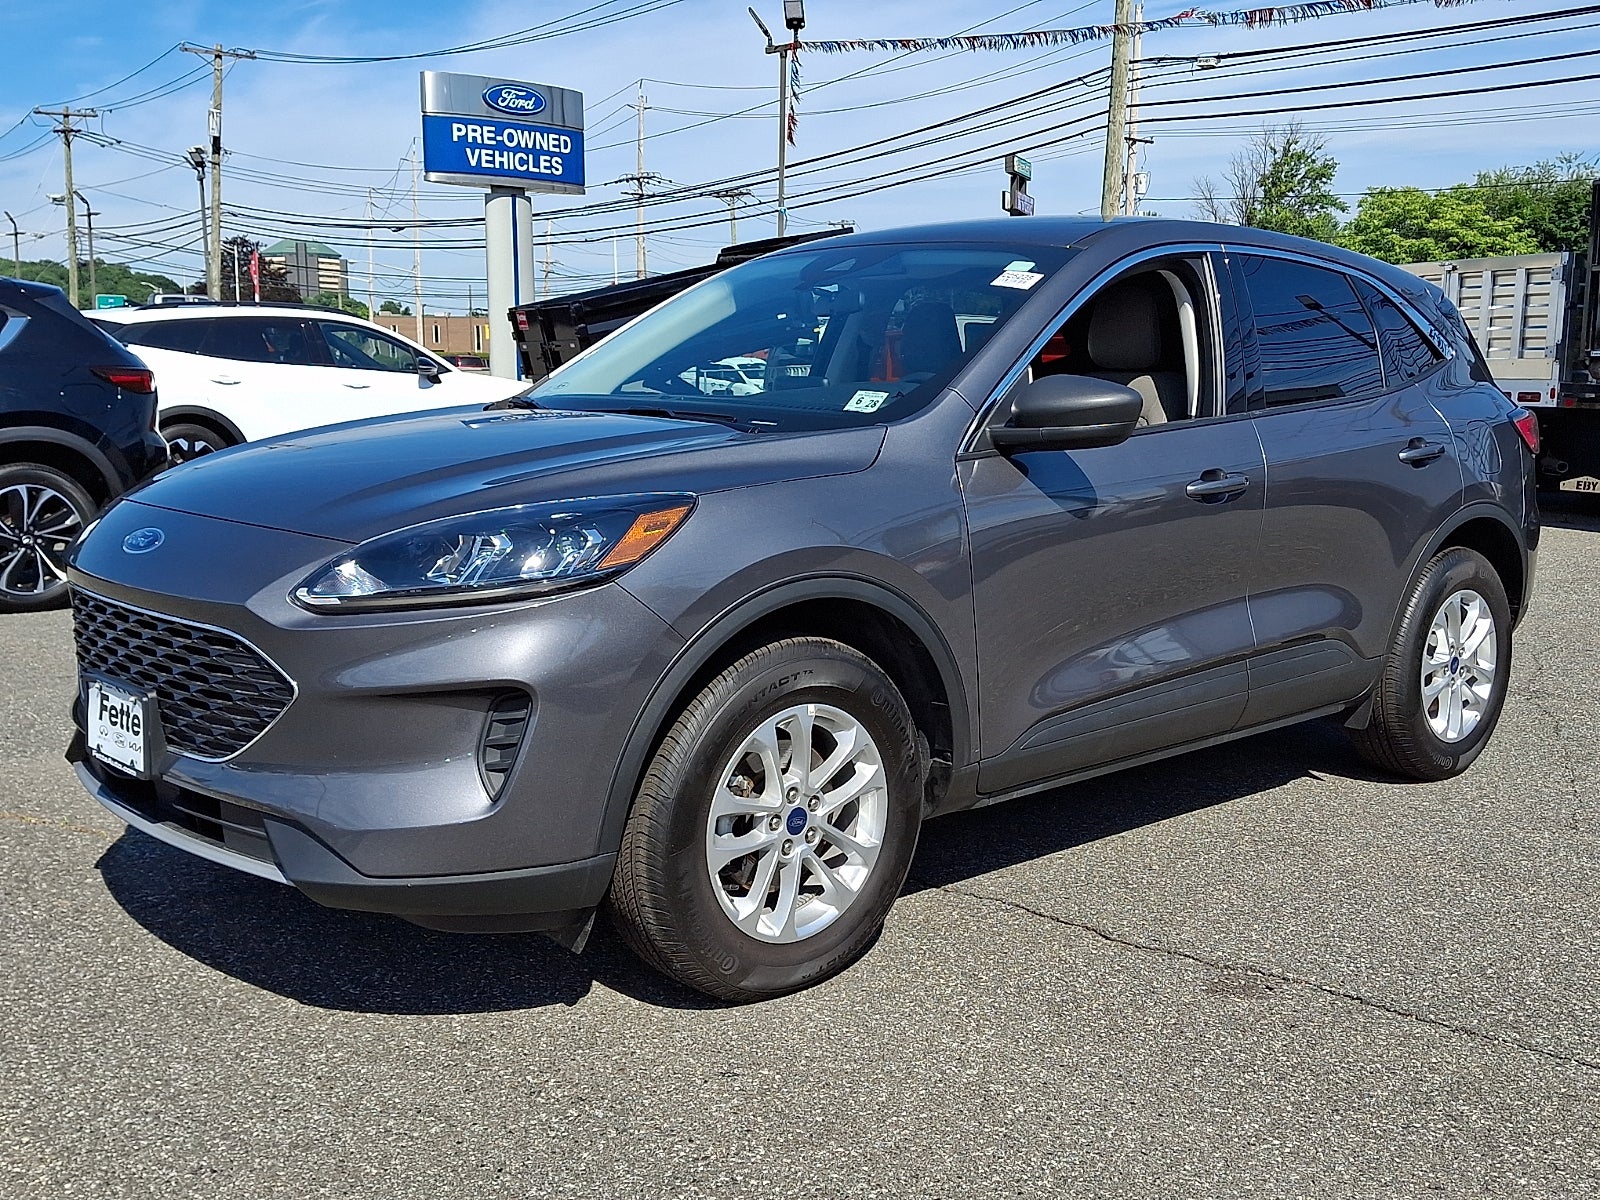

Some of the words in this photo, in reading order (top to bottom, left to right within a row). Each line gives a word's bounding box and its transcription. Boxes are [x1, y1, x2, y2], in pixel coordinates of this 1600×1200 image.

[497, 88, 535, 110] Ford
[452, 123, 571, 154] PRE-OWNED
[466, 148, 563, 175] VEHICLES
[856, 397, 864, 405] 6
[1576, 480, 1599, 491] EBY
[99, 691, 140, 737] Fette
